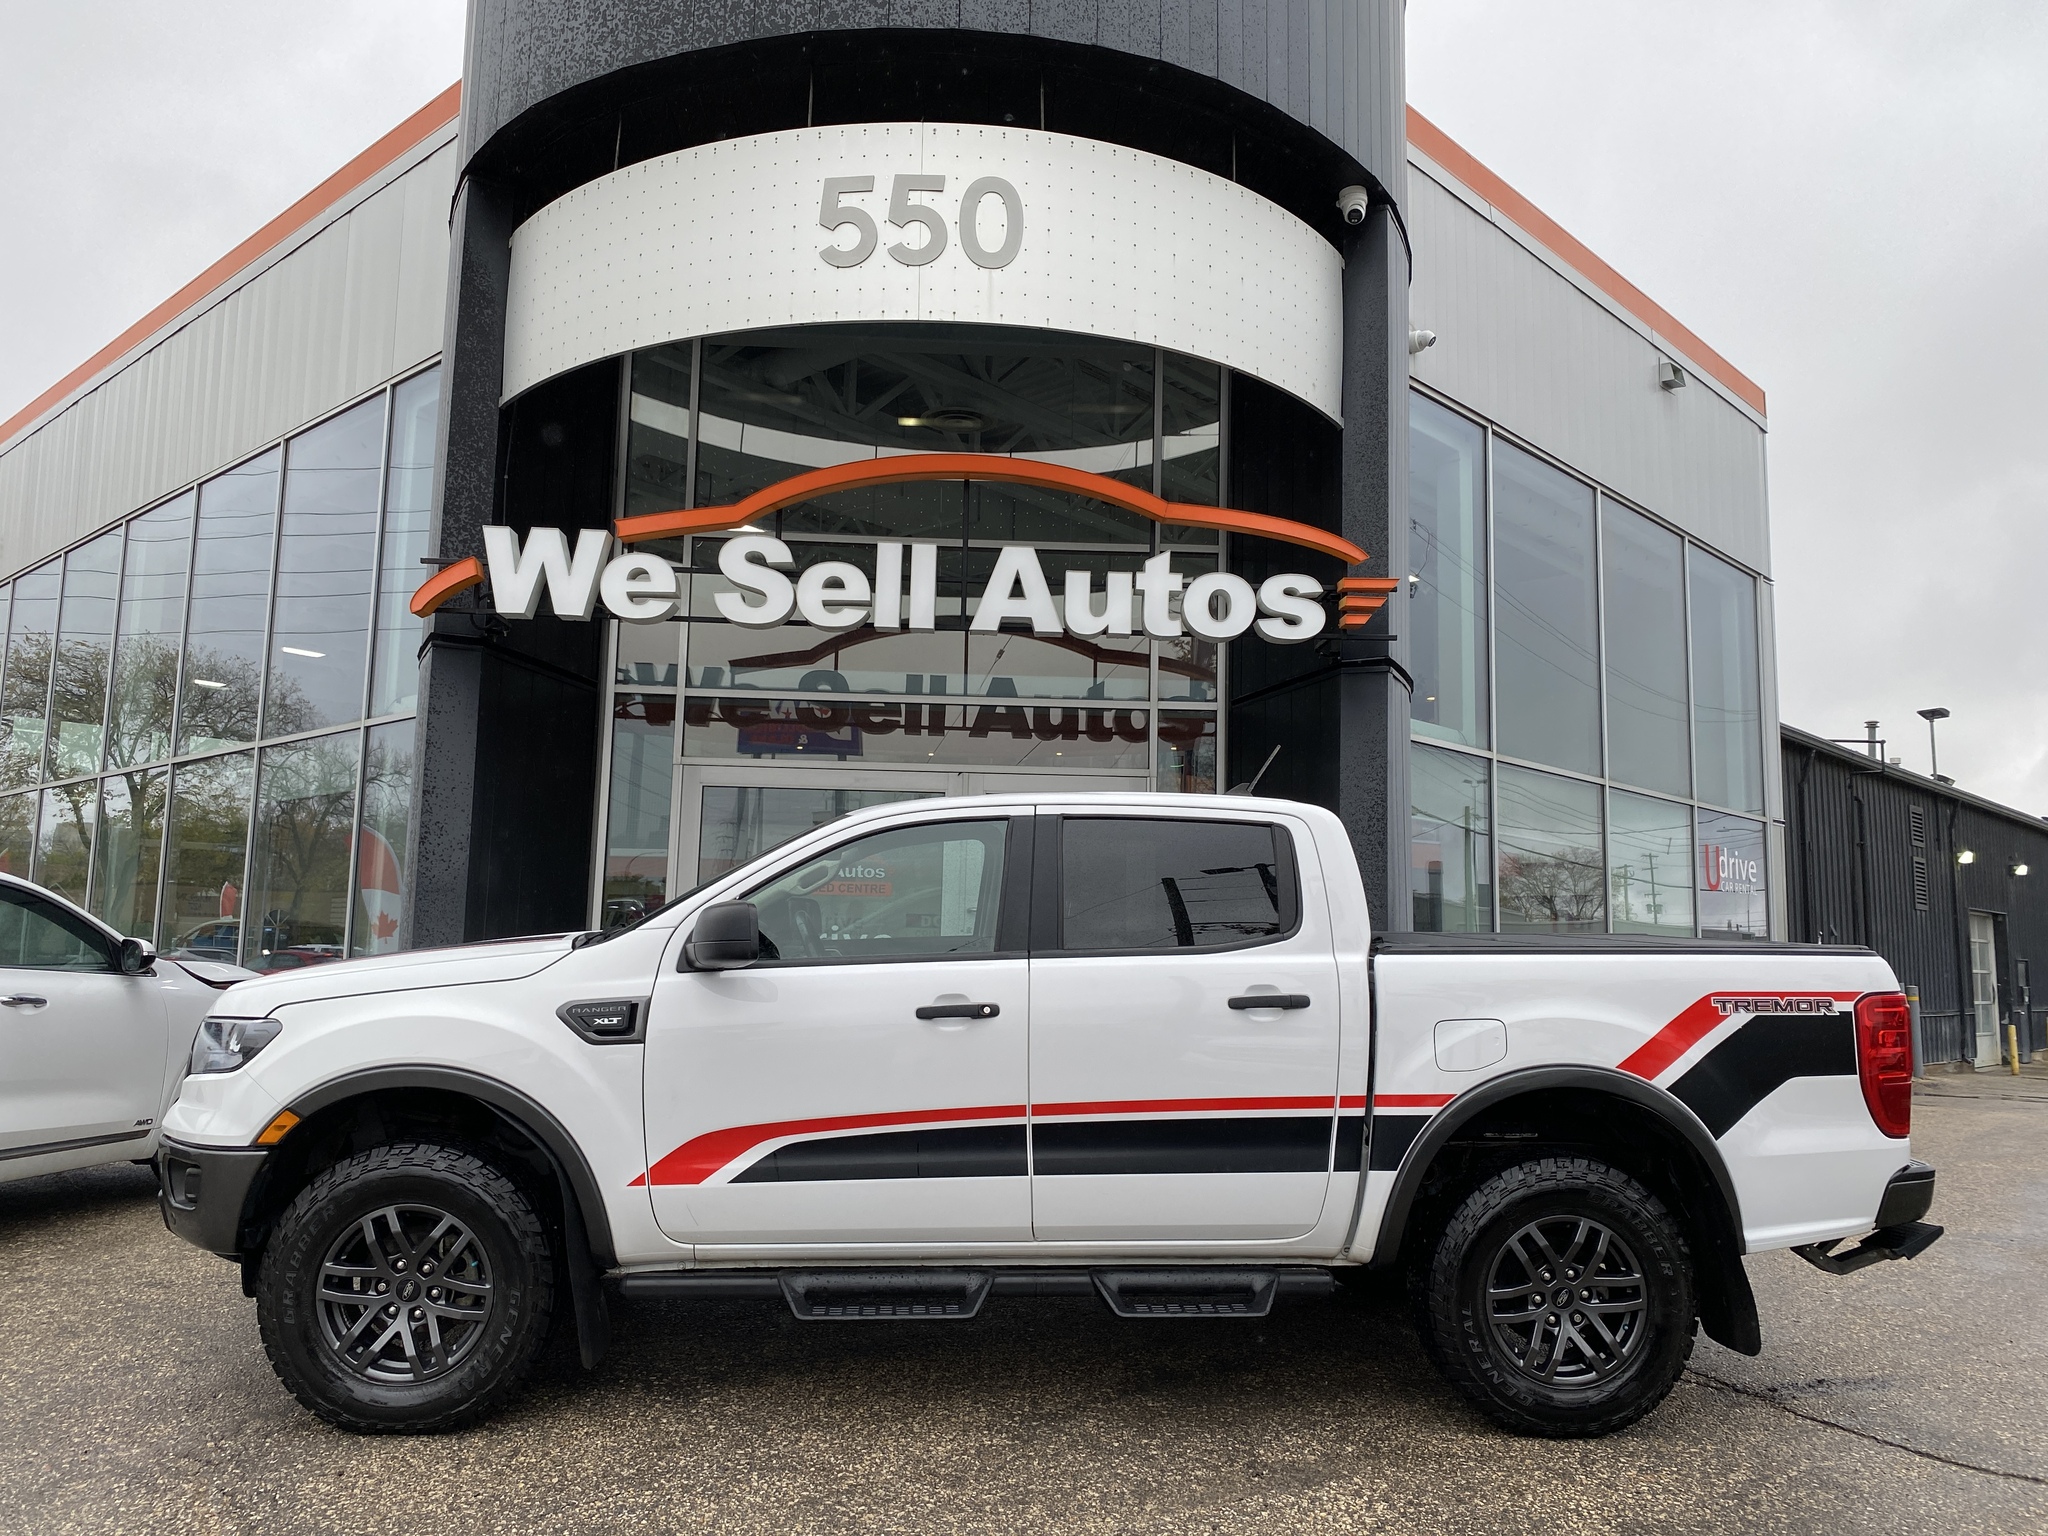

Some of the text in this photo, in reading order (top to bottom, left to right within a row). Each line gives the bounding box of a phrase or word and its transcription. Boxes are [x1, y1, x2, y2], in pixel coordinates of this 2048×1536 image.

[818, 173, 1024, 270] 550
[482, 525, 1326, 645] We Sell Autos
[798, 670, 946, 736] Sell
[969, 677, 1206, 743] Autos
[838, 883, 886, 894] CENTRE
[1705, 844, 1757, 891] Udrive
[1721, 881, 1758, 896] CAR RENTAL
[572, 1006, 627, 1014] RANGER
[593, 1017, 622, 1025] XLT
[1711, 997, 1839, 1015] TREMOR
[133, 1118, 154, 1127] AWD
[1585, 1191, 1674, 1276] GRABBER
[282, 1205, 336, 1325] GRABBER
[1462, 1301, 1538, 1406] GENERAL
